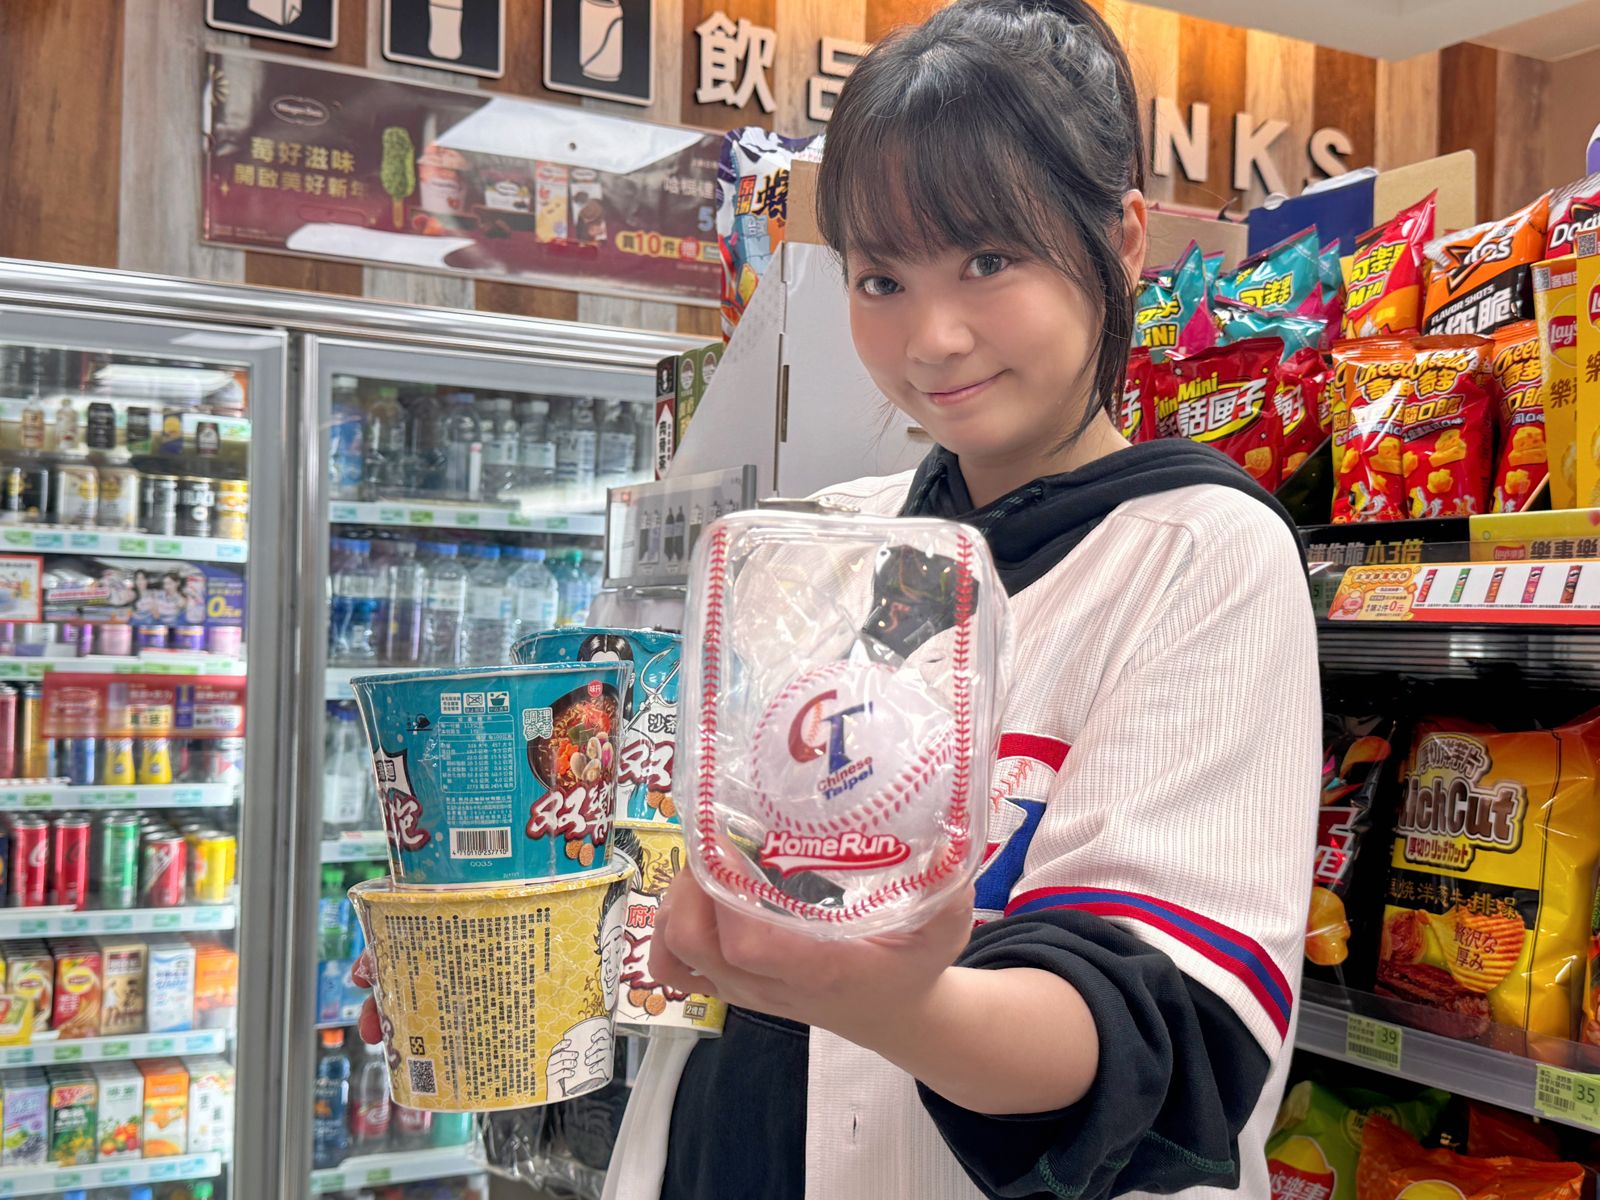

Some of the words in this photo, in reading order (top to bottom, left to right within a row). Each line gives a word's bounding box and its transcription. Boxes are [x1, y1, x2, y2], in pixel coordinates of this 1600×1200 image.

[1430, 302, 1461, 326] FLAVOR
[1178, 372, 1218, 403] Mini
[1417, 369, 1458, 396] 奇多
[1178, 378, 1267, 436] 話匣子
[817, 755, 873, 791] Chinese
[822, 766, 874, 801] Taipei
[760, 830, 896, 858] HomeRun
[1382, 1027, 1397, 1045] 39
[1576, 1084, 1595, 1104] 35
